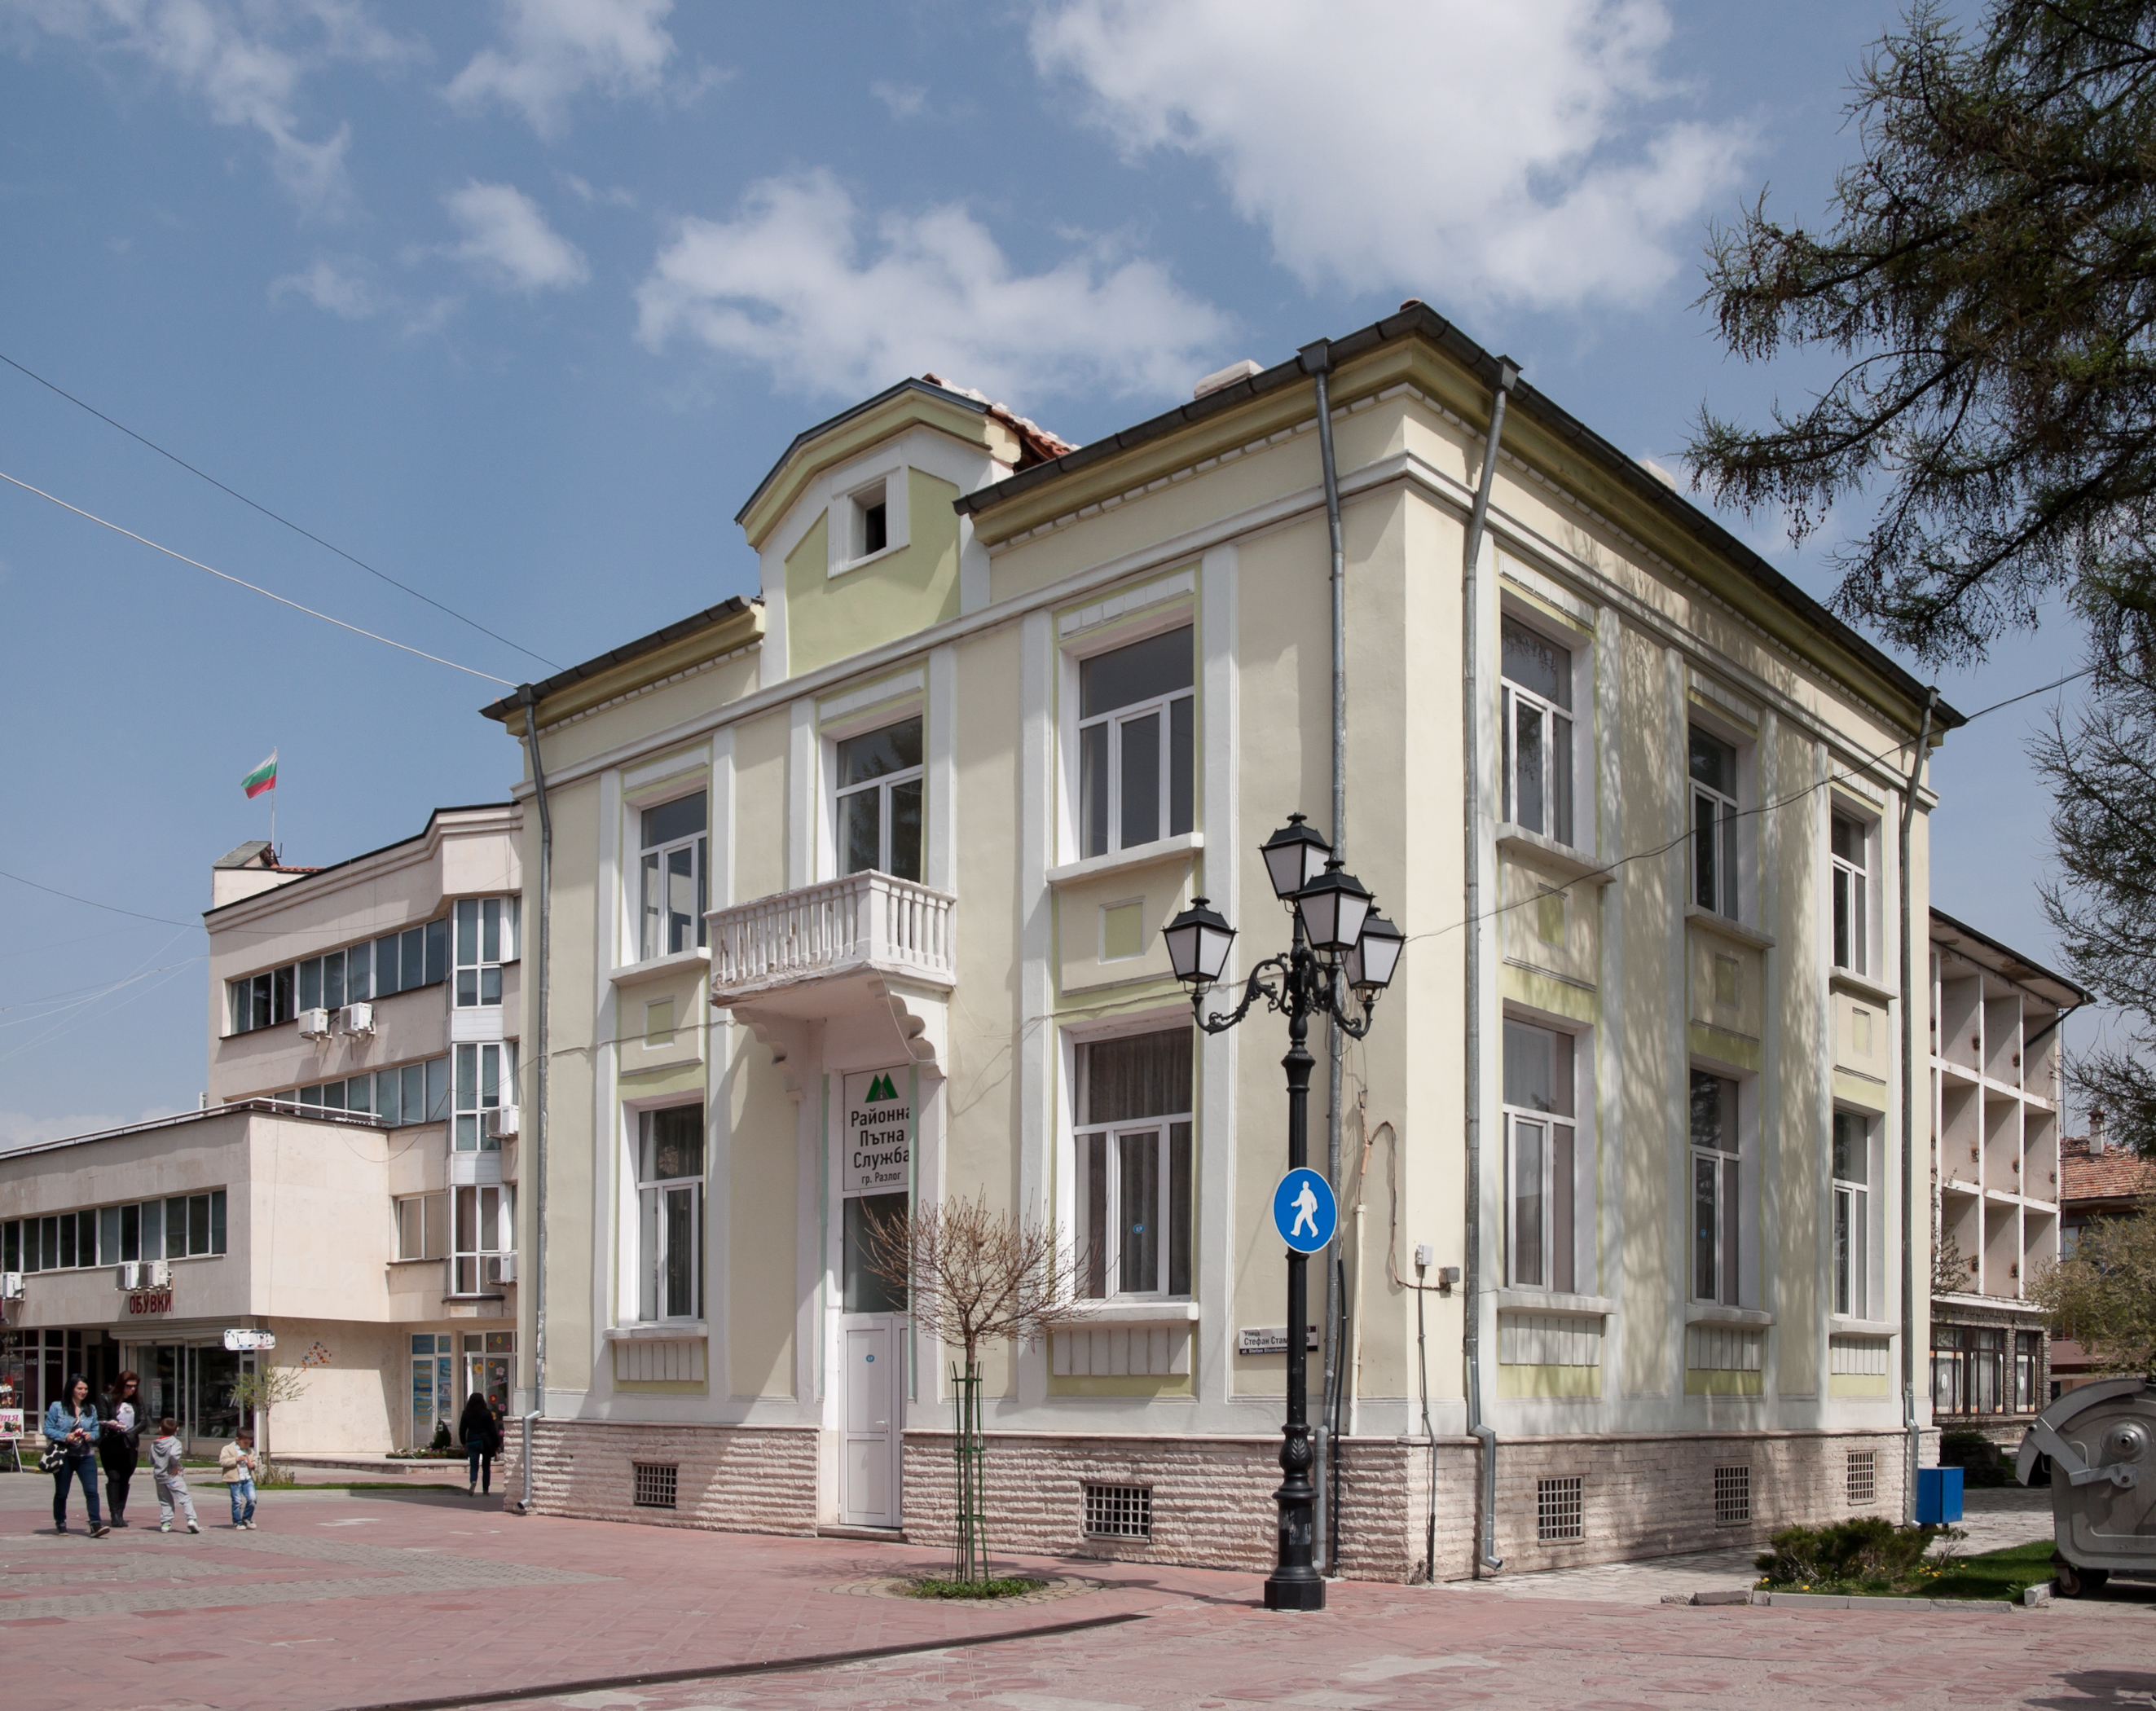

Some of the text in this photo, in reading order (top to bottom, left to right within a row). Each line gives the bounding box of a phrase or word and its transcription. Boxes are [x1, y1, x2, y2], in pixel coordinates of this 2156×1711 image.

[860, 1128, 904, 1147] Пътна
[853, 1146, 909, 1171] Служба
[861, 1172, 902, 1186] гр. Разлог
[129, 1293, 172, 1314] ОБУВКИ
[1243, 1337, 1269, 1347] Стефан
